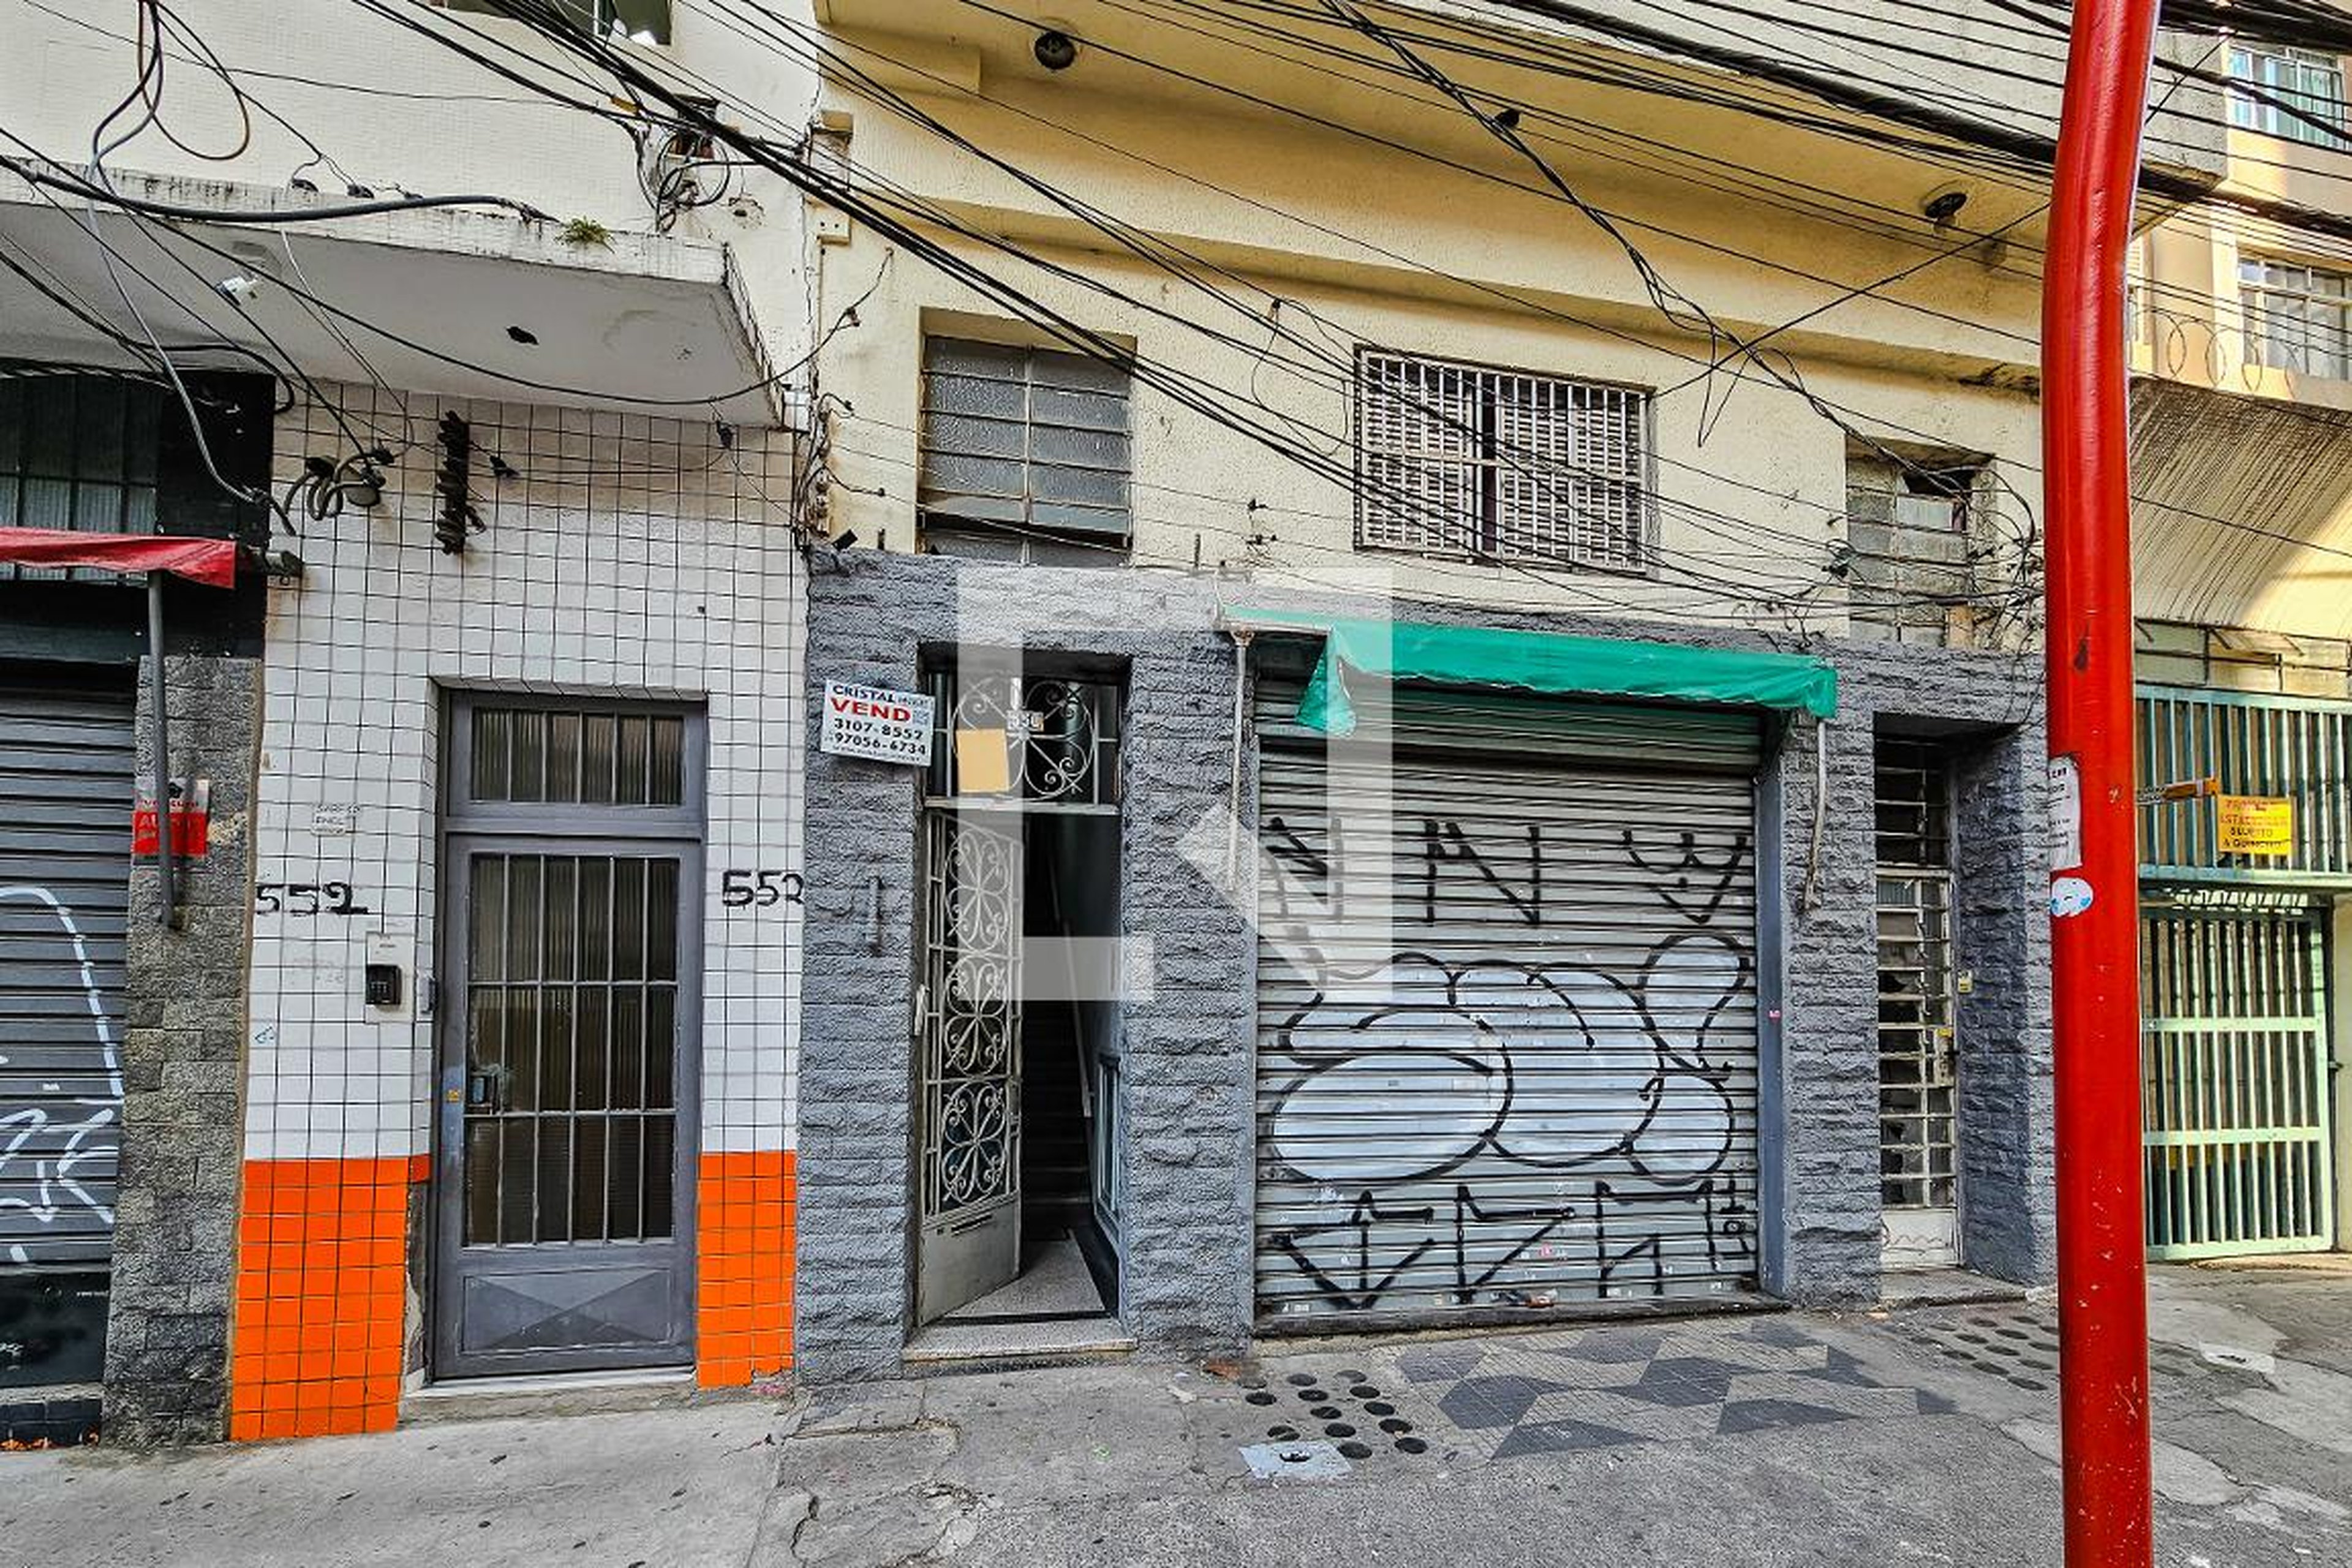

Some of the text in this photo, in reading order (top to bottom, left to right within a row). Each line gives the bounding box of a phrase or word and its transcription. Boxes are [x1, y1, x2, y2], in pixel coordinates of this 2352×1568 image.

[832, 685, 896, 704] CRISTAL
[831, 697, 911, 722] VEND
[834, 733, 927, 755] 97056-6734
[255, 881, 368, 916] 552
[722, 870, 805, 908] 552
